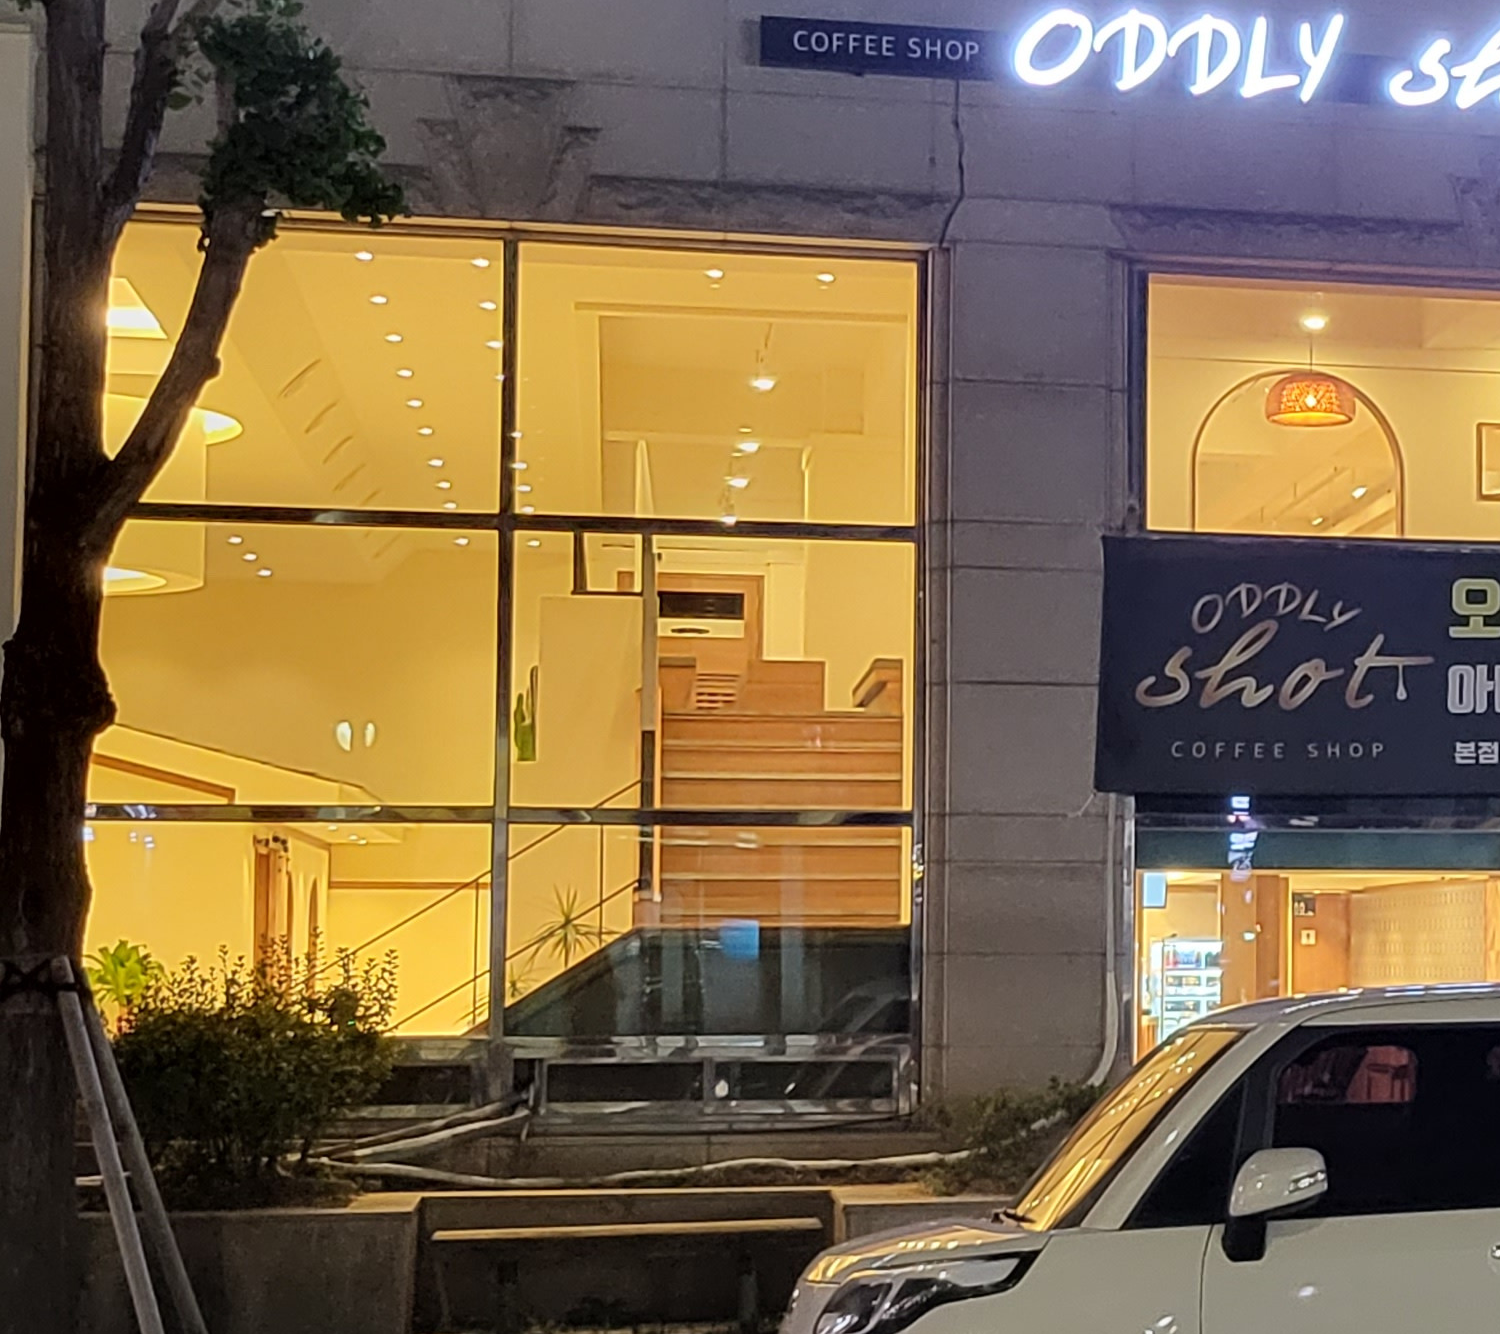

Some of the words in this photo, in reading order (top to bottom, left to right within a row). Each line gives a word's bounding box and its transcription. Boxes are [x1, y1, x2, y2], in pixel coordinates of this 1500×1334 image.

[793, 30, 896, 57] COFFEE
[907, 37, 979, 62] SHOP
[1012, 7, 1345, 103] ODDLY
[1191, 581, 1363, 634] ODDLY
[1135, 619, 1435, 711] shot
[1171, 741, 1285, 759] COFFEE
[1307, 742, 1384, 759] SHOP
[1454, 741, 1499, 765] 본점
